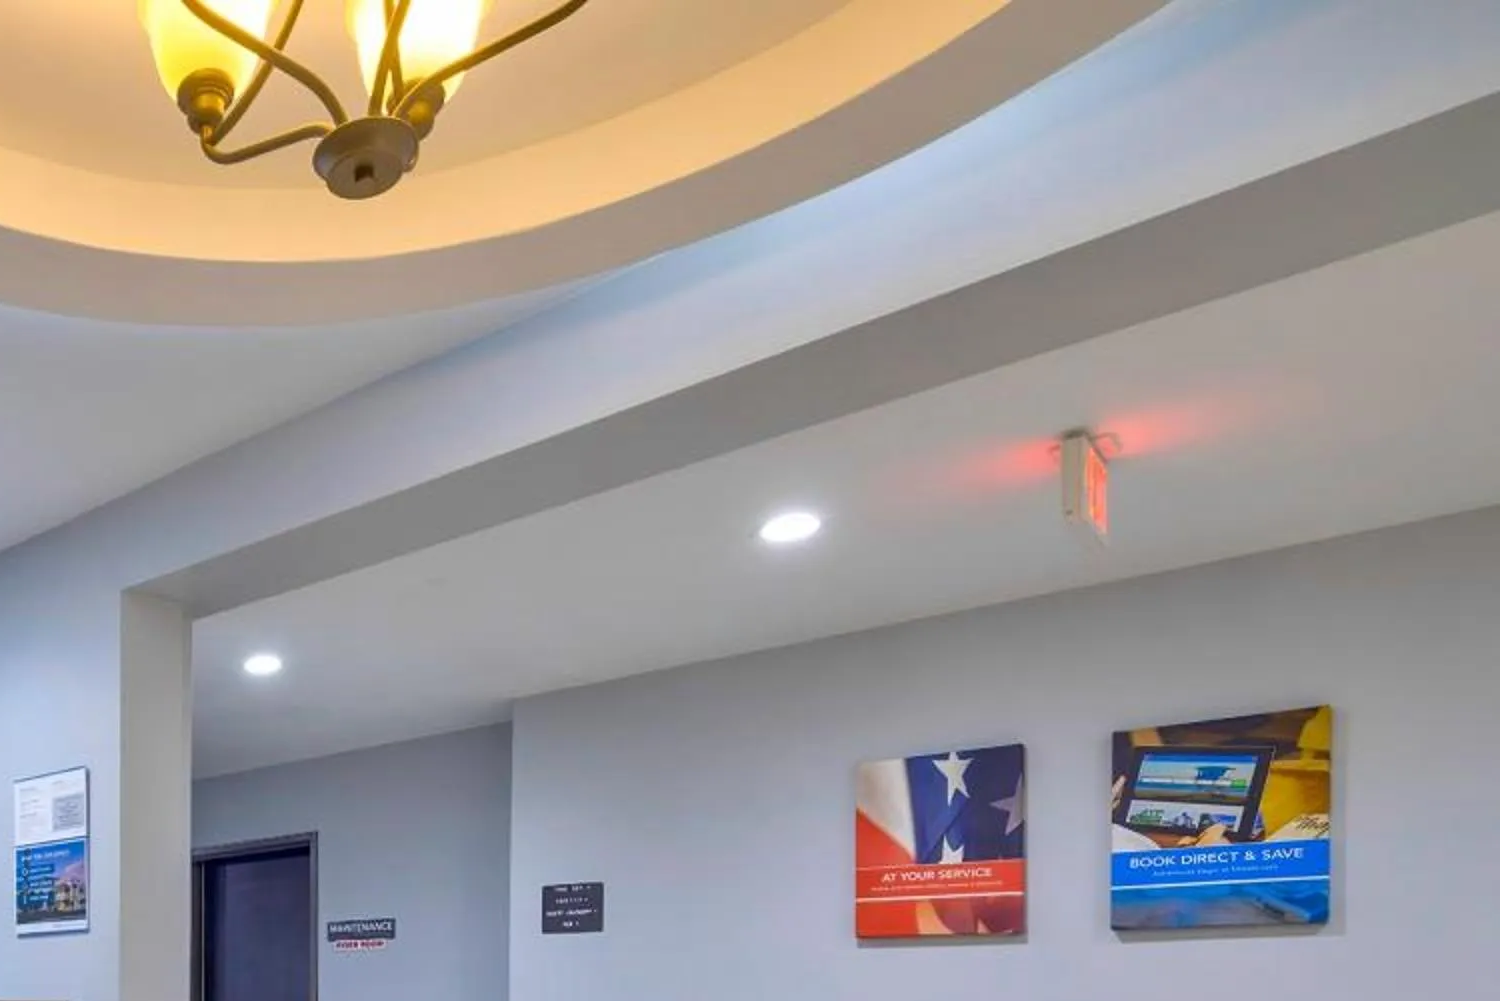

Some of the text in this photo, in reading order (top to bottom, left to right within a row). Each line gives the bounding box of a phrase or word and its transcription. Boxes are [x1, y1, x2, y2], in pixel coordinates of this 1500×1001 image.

[1129, 847, 1305, 869] BOOK DIRECT & SAVE
[882, 867, 993, 882] AT YOUR SERVICE
